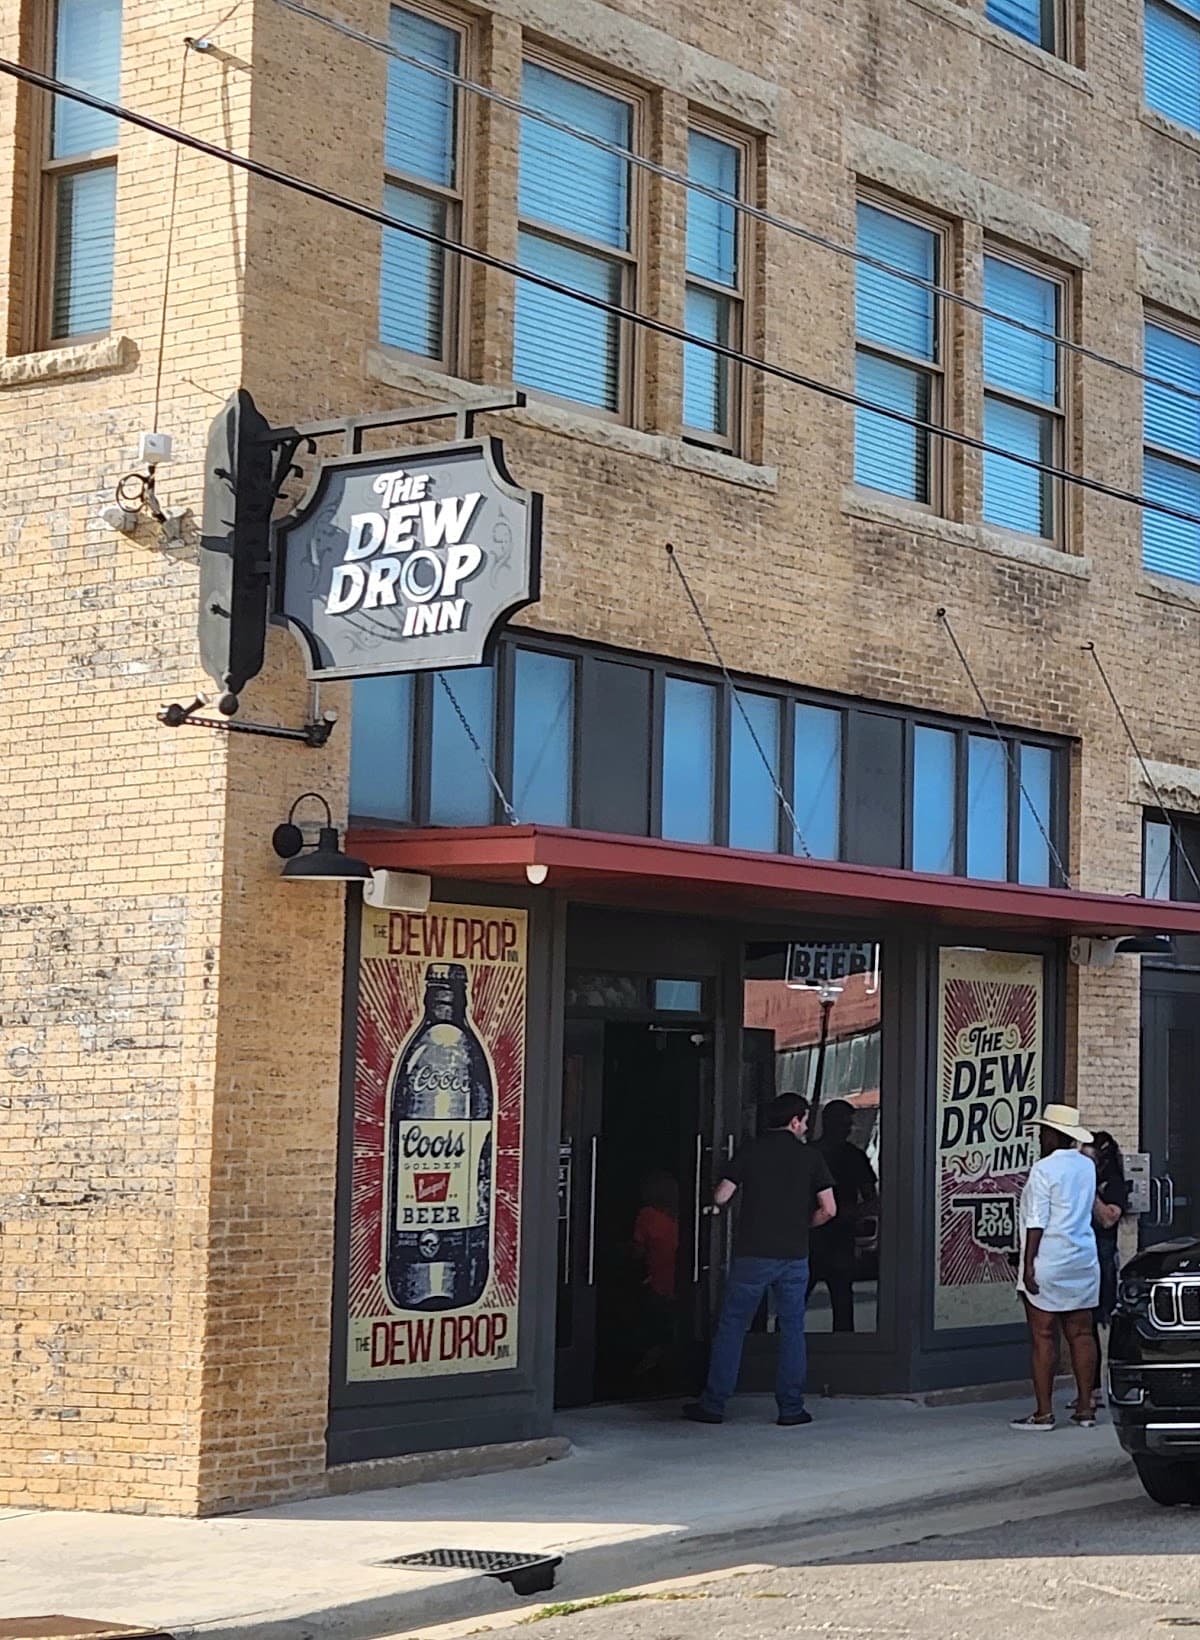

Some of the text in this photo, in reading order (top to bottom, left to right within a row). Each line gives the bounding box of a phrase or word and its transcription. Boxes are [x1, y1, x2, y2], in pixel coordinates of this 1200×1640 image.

[373, 470, 430, 509] THE
[344, 492, 482, 561] DEW
[324, 544, 483, 615] DROP
[402, 599, 466, 637] INN
[388, 912, 448, 957] DEW
[453, 917, 517, 961] DROP
[969, 1027, 1004, 1057] THE
[952, 1052, 1036, 1101] DEW
[402, 1125, 466, 1158] Coors
[940, 1095, 1038, 1149] DROP
[992, 1142, 1029, 1171] INN
[403, 1207, 460, 1224] BEER
[977, 1219, 1012, 1237] 2019
[371, 1319, 434, 1367] DEW
[440, 1313, 507, 1360] DROP
